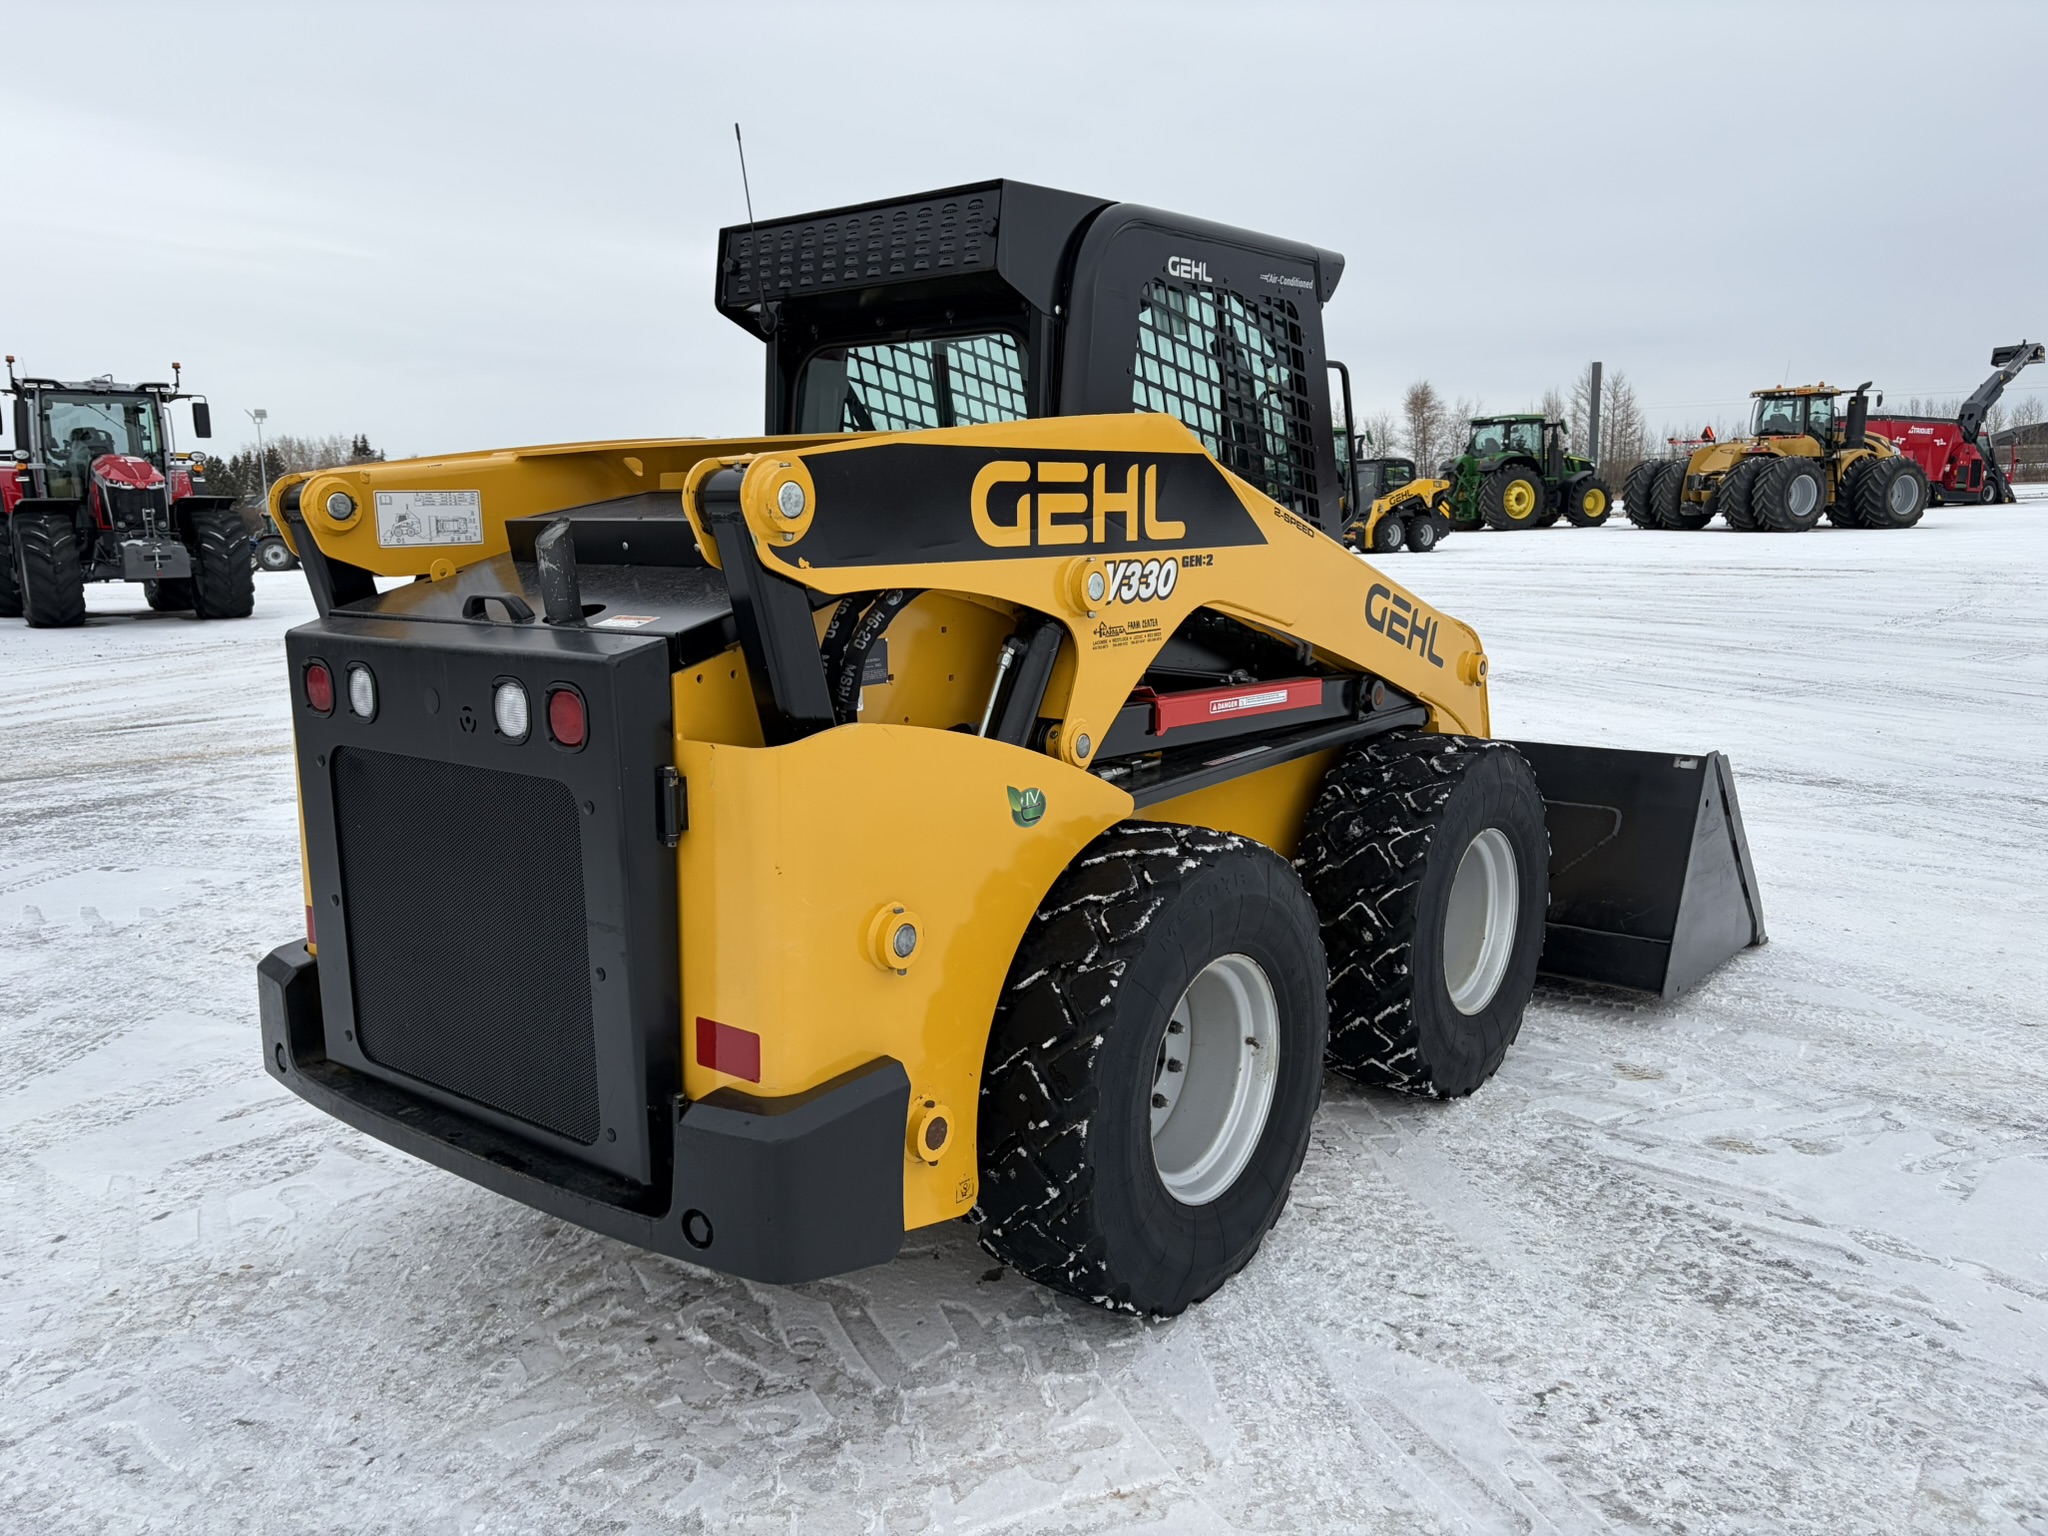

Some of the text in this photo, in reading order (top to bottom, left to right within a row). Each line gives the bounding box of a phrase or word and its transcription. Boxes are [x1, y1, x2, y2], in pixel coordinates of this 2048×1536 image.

[1168, 255, 1213, 283] GEHL
[1268, 273, 1314, 290] Air-Conditioned
[970, 460, 1187, 548] GEHL
[1388, 489, 1414, 506] GEHL
[1273, 506, 1315, 539] 2-SPEED
[1181, 554, 1214, 568] GEN:2
[854, 608, 885, 650] HG-20
[1127, 620, 1141, 630] FARM
[1365, 582, 1444, 669] GEHL
[1217, 700, 1238, 710] DANGER
